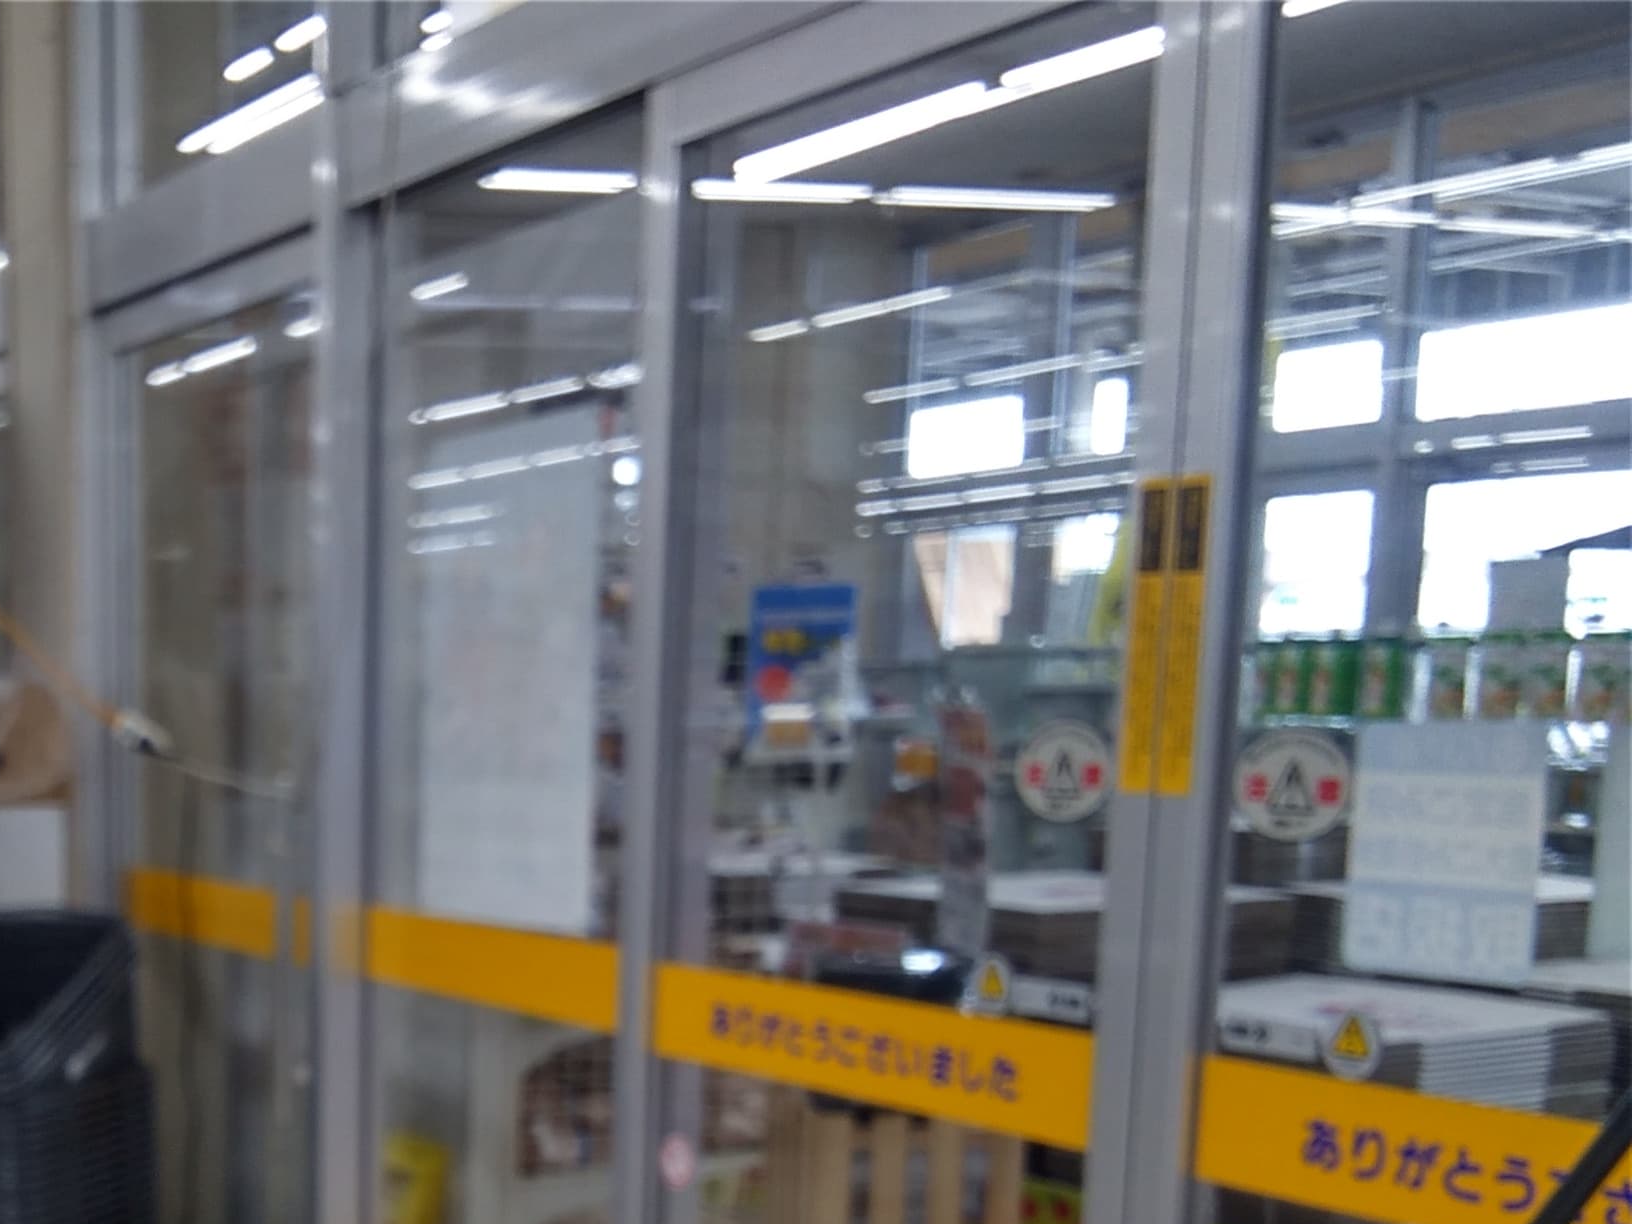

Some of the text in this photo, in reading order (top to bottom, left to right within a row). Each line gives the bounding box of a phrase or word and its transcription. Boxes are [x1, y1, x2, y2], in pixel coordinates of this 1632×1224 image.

[710, 1000, 1023, 1102] ありがとうございました
